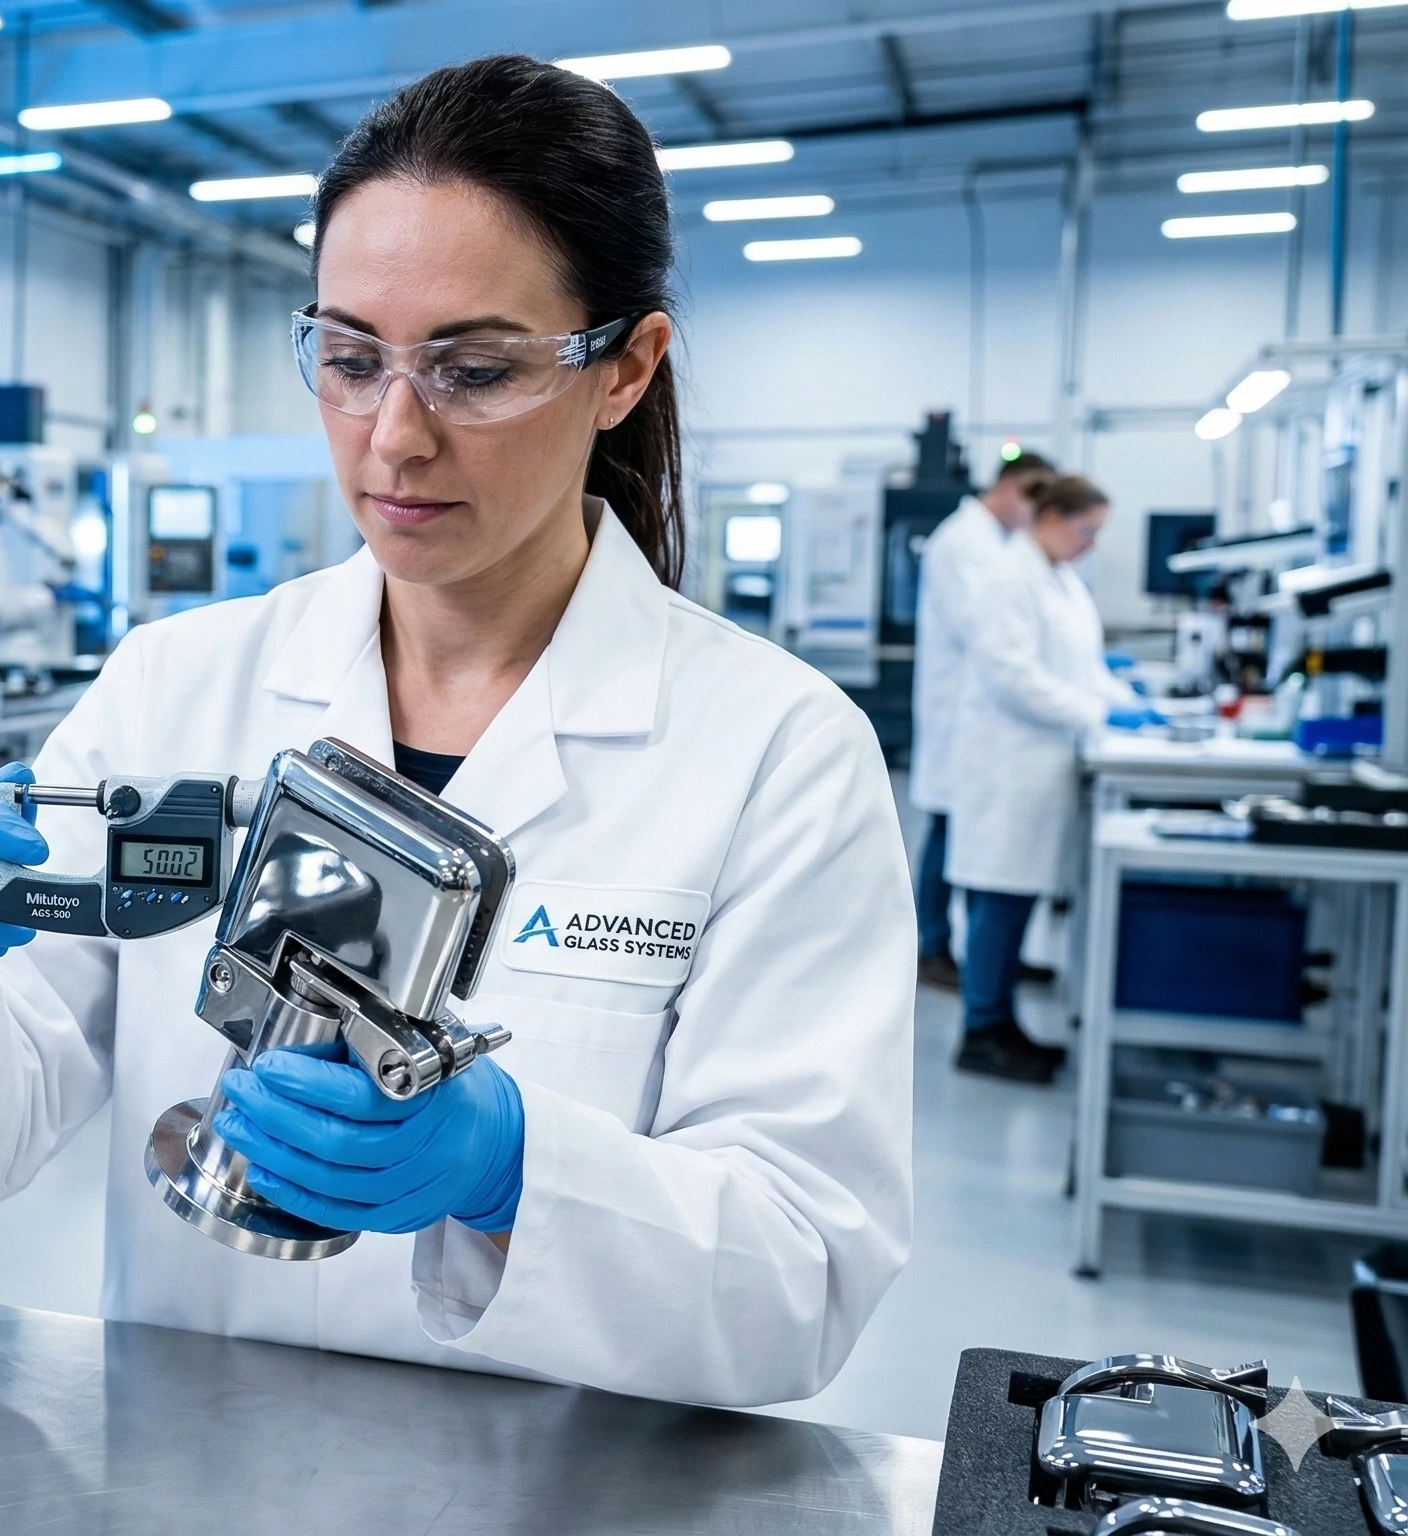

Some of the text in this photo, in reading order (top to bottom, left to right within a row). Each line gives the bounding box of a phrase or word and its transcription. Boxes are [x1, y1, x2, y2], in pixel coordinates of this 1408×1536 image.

[143, 849, 197, 876] 50.02
[26, 892, 80, 910] Mitutoyo
[31, 908, 71, 919] AGS-500
[566, 913, 696, 941] ADVANCED
[564, 935, 692, 960] GLASS SYSTEMS
